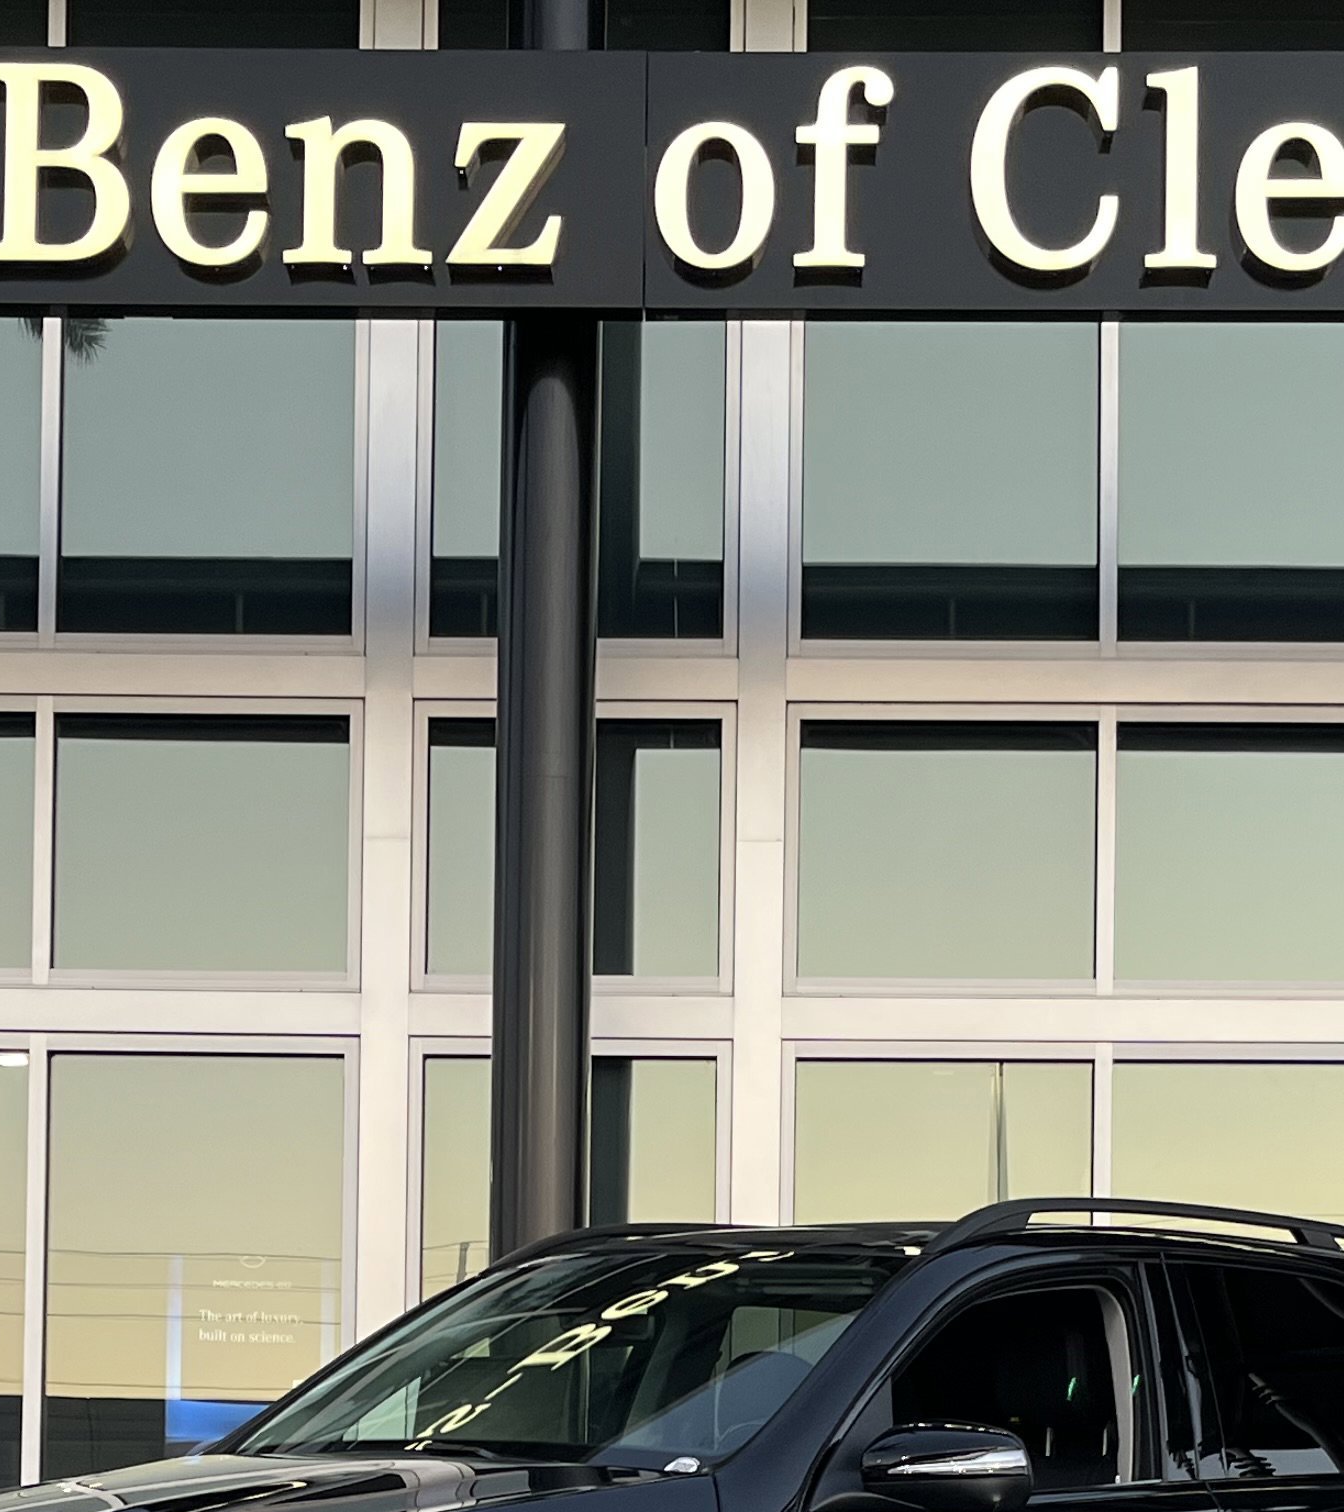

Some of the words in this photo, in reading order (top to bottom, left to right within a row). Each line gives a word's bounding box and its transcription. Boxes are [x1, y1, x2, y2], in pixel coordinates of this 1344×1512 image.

[654, 65, 895, 270] of
[199, 1309, 222, 1321] The
[225, 1312, 242, 1322] art
[246, 1311, 258, 1323] of
[199, 1328, 226, 1341] built
[230, 1333, 245, 1342] on
[249, 1331, 296, 1343] science.
